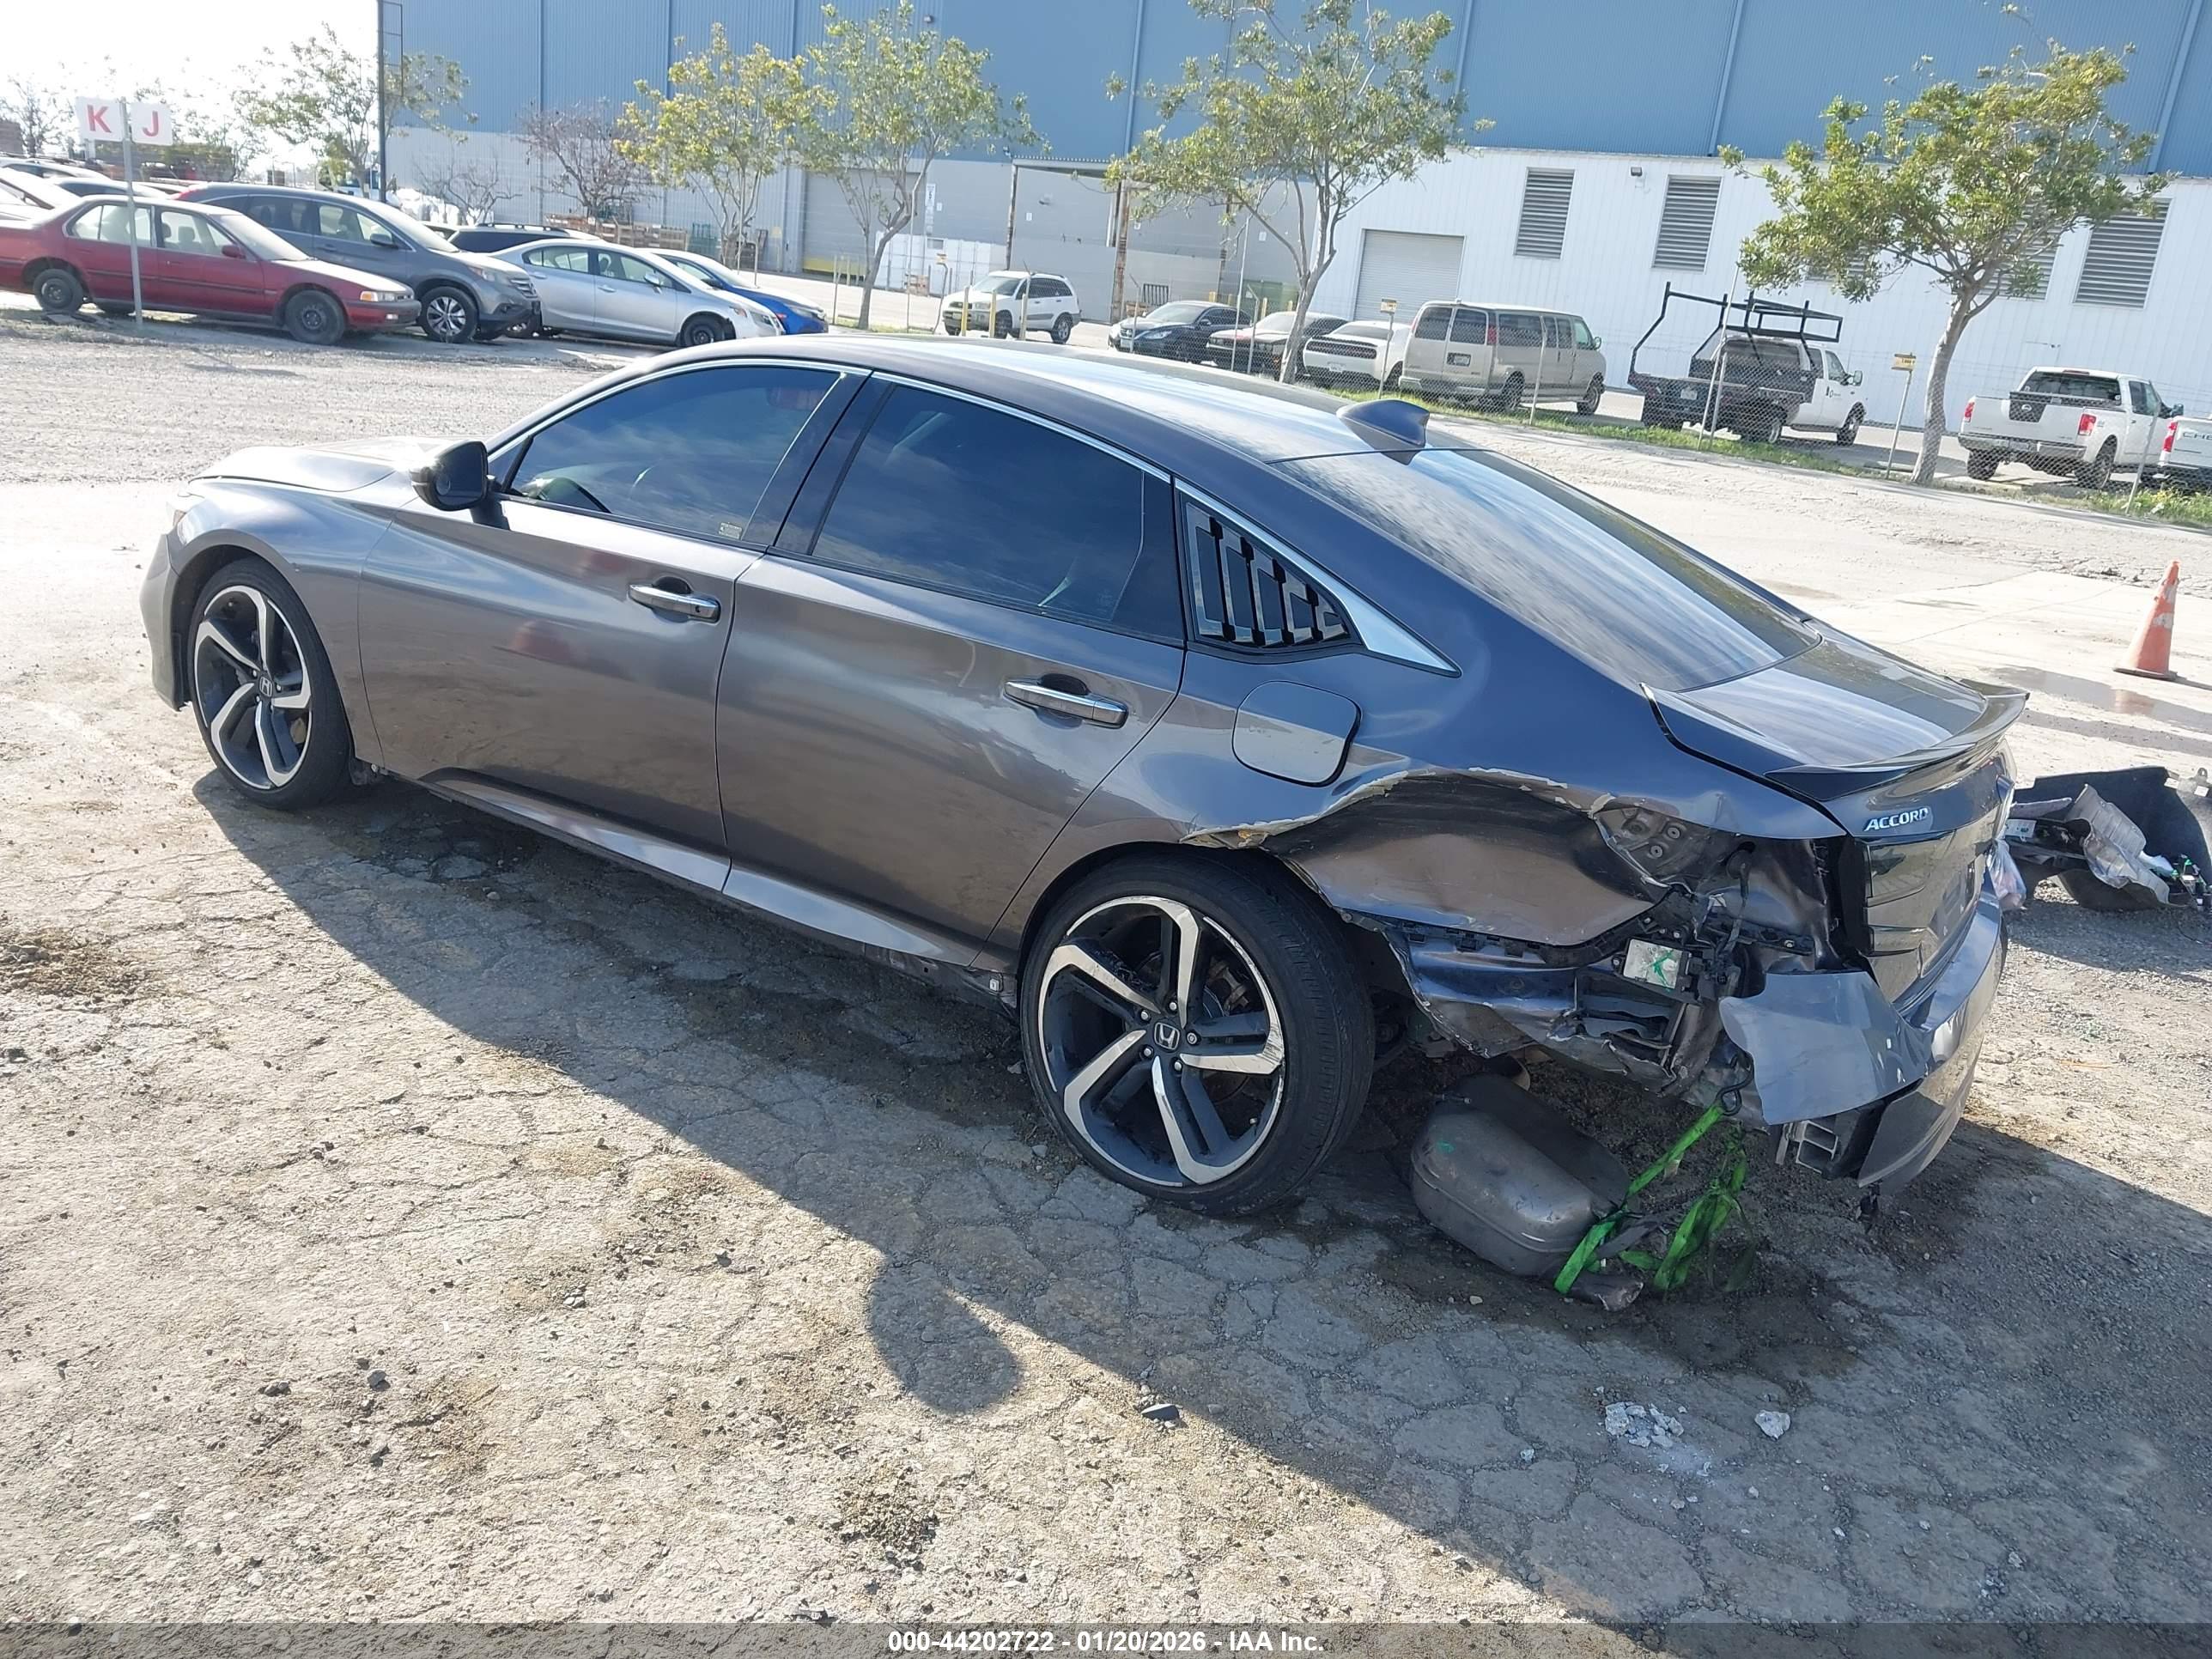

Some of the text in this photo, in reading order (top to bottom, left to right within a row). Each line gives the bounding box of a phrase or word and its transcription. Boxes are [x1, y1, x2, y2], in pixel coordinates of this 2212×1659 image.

[87, 104, 112, 133] K
[143, 111, 159, 137] J
[1863, 807, 1929, 832] ACCORD
